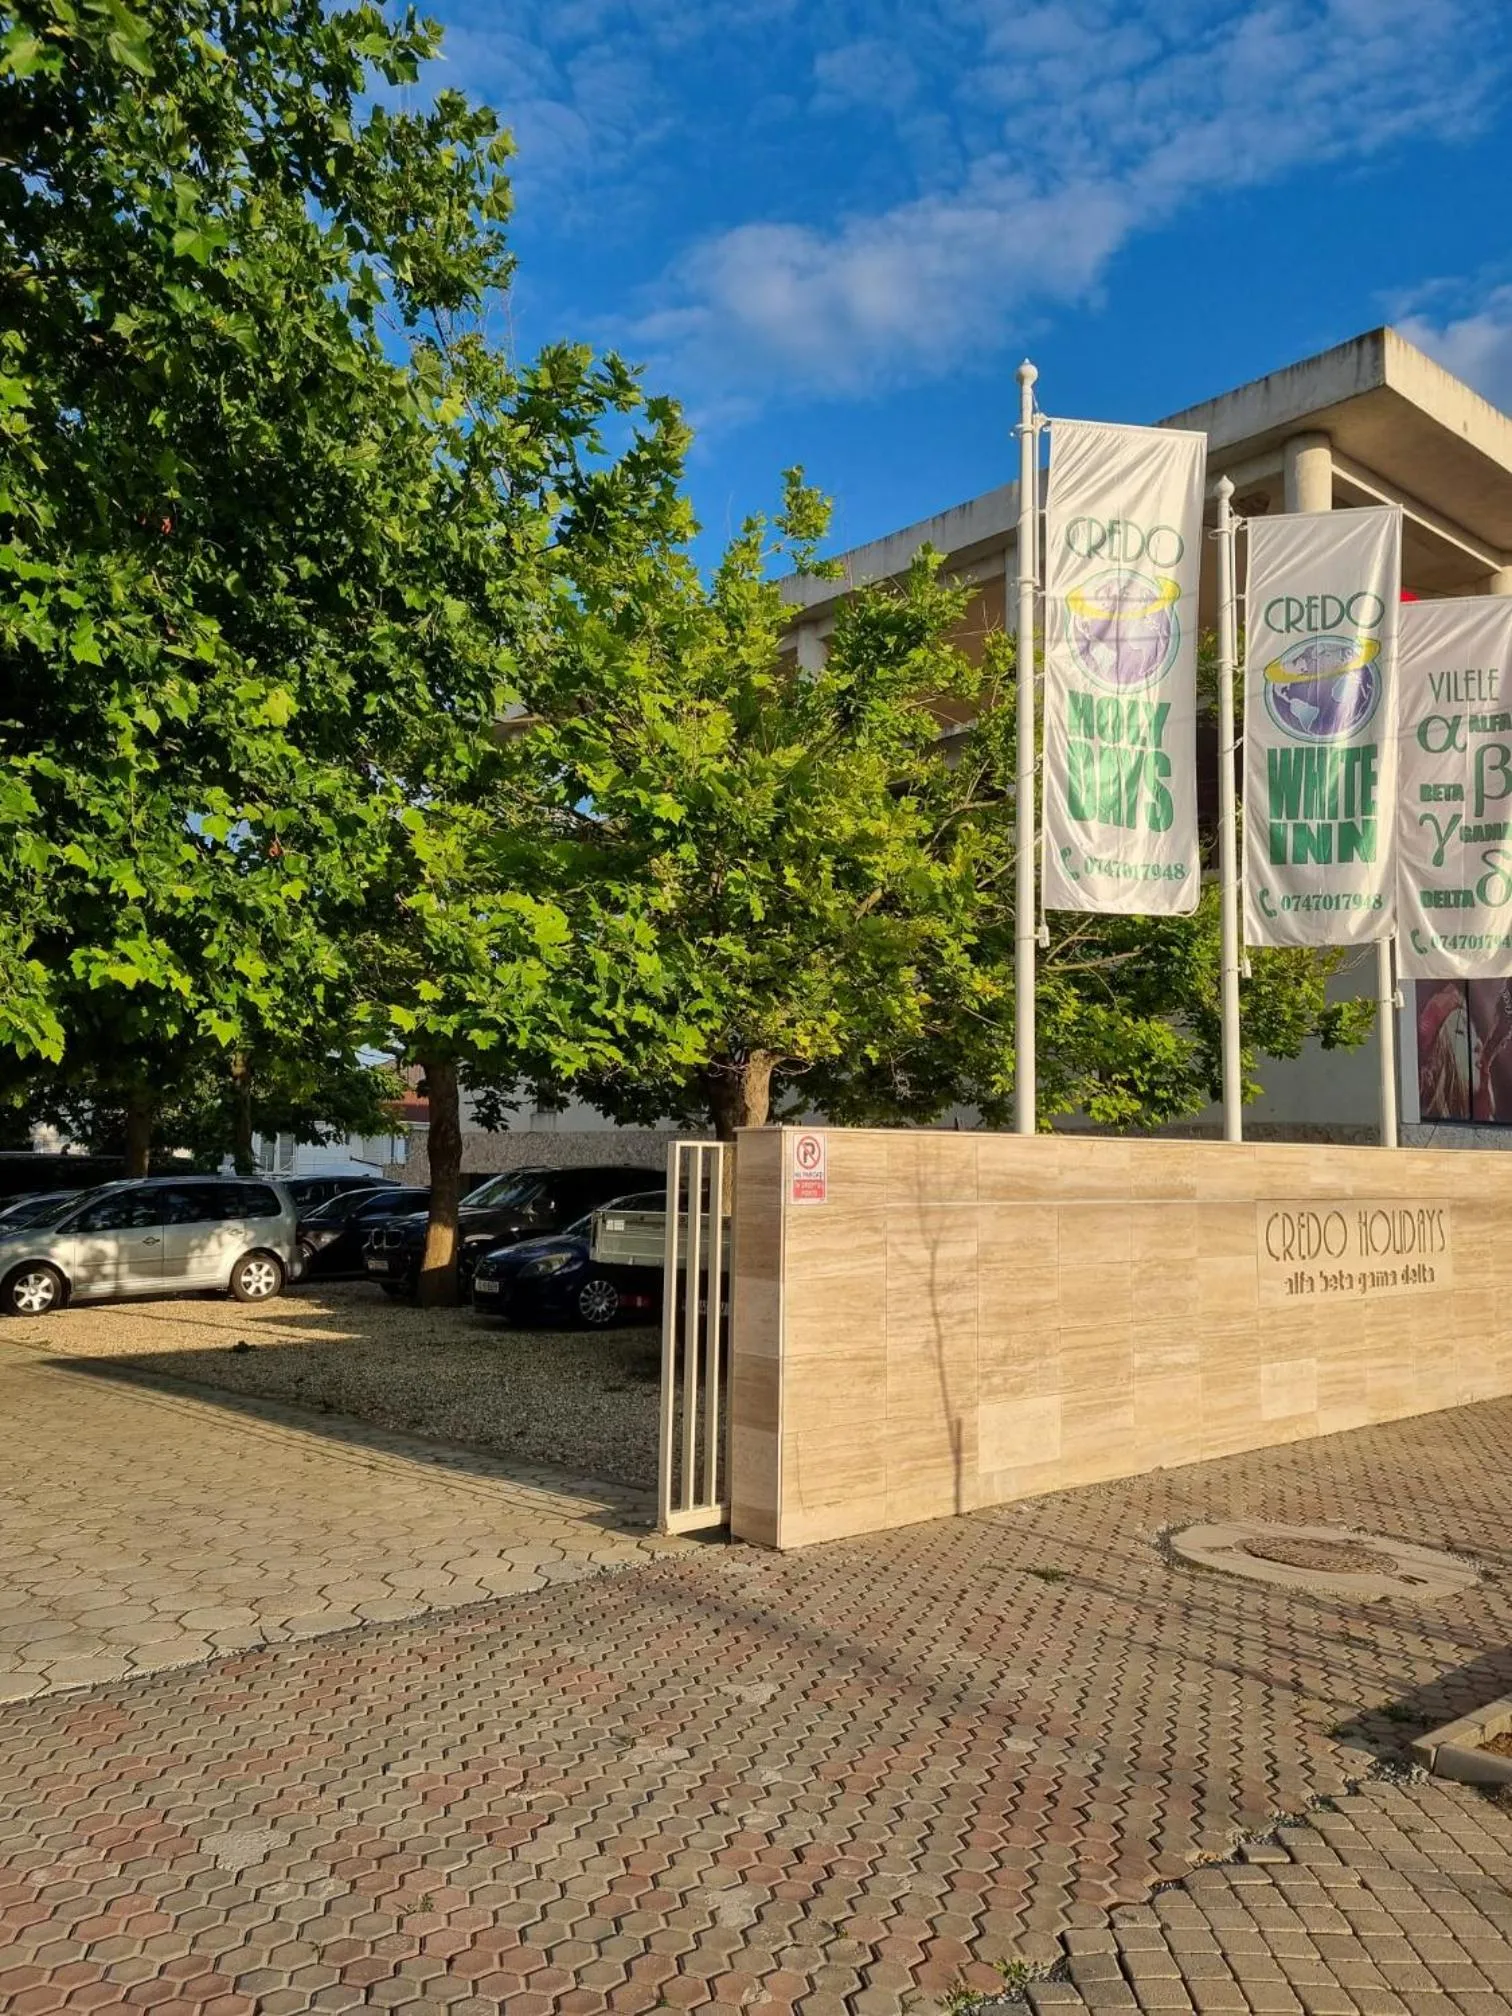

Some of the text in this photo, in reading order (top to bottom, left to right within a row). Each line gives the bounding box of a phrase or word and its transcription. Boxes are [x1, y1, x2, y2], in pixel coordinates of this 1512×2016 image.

[1065, 517, 1184, 567] CREDO
[1265, 592, 1385, 634] CREDO
[1428, 669, 1499, 703] VILELE
[1068, 690, 1171, 750] HOLY
[1067, 740, 1174, 832] DAYS
[1267, 744, 1379, 821] WHITE
[1419, 783, 1465, 802] BETA
[1269, 820, 1377, 865] INN
[1083, 856, 1186, 881] 0747017948
[1420, 888, 1476, 909] DELTA
[1265, 1208, 1446, 1262] CREDO HOLIDAYS
[1283, 1263, 1435, 1296] alfa beta gama delta
